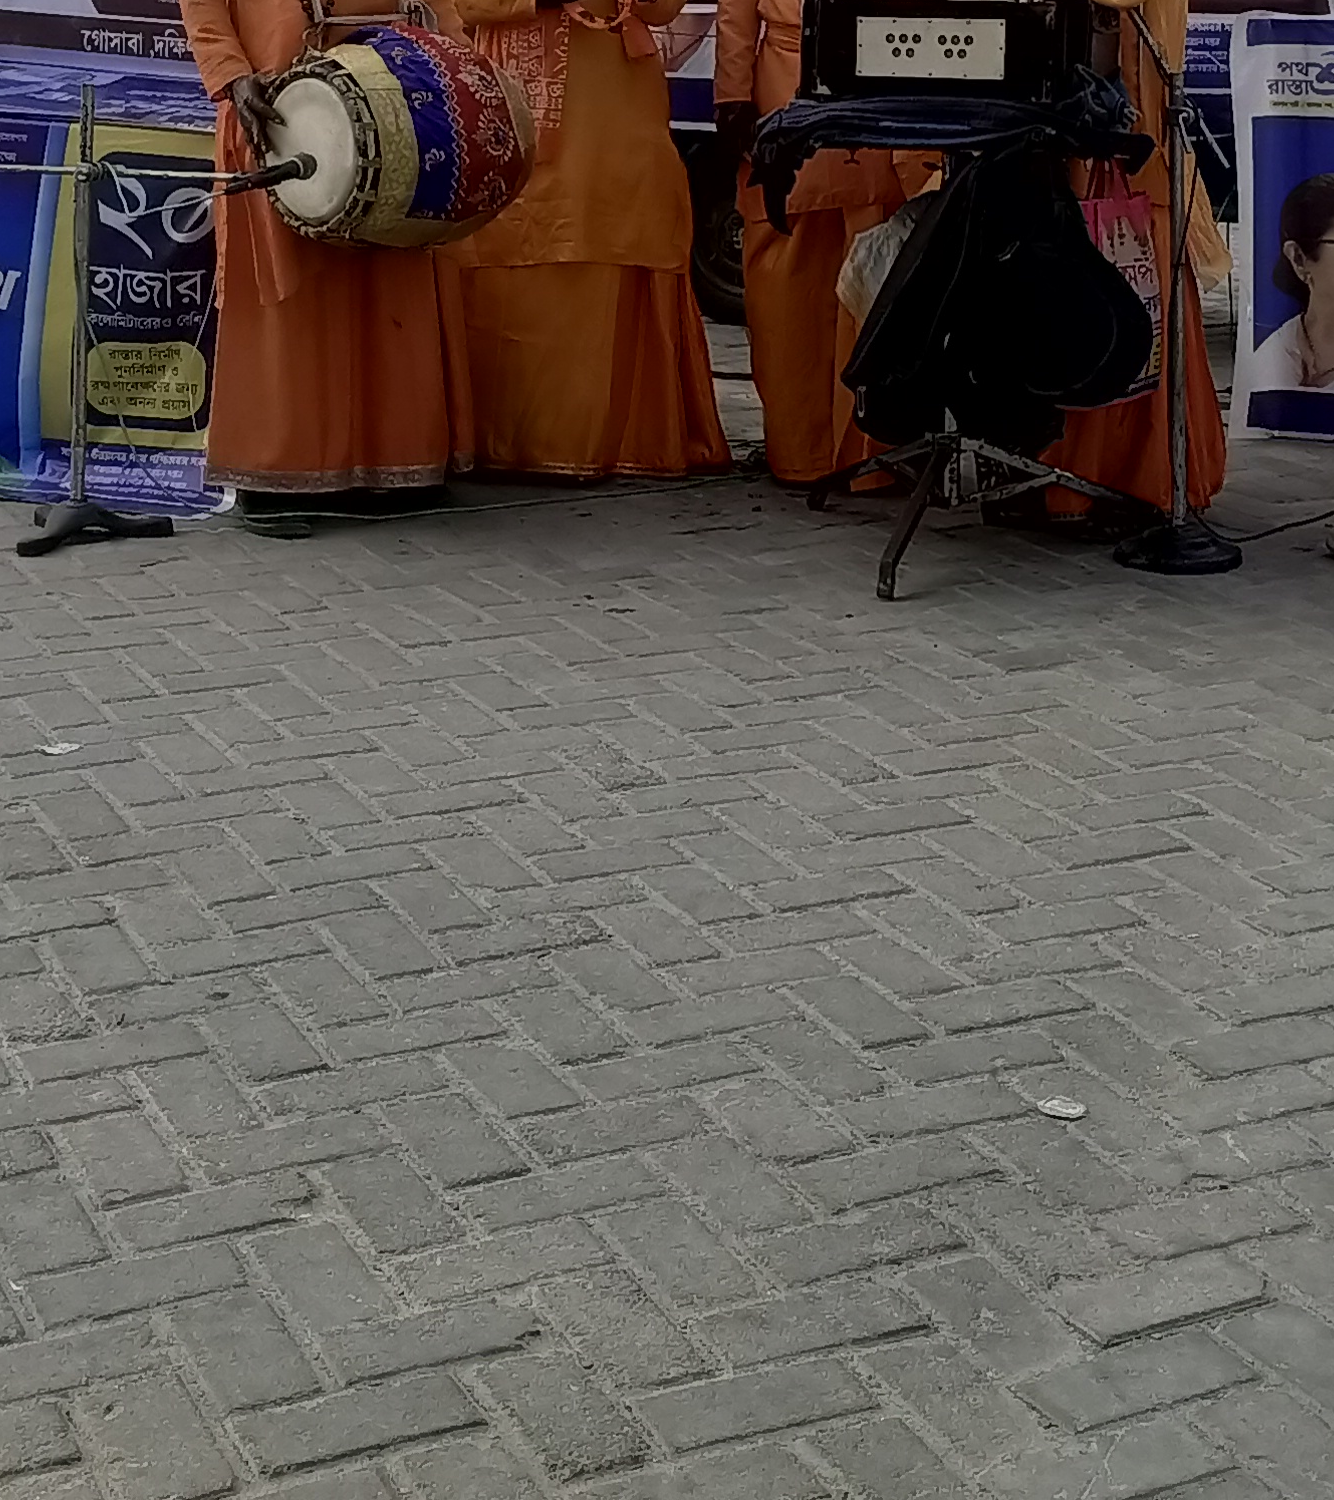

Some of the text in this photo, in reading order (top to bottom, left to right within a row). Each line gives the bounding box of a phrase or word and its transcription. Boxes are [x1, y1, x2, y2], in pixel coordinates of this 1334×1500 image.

[80, 28, 144, 55] গোসাবা
[97, 177, 215, 260] ২০
[89, 264, 207, 310] হাজার
